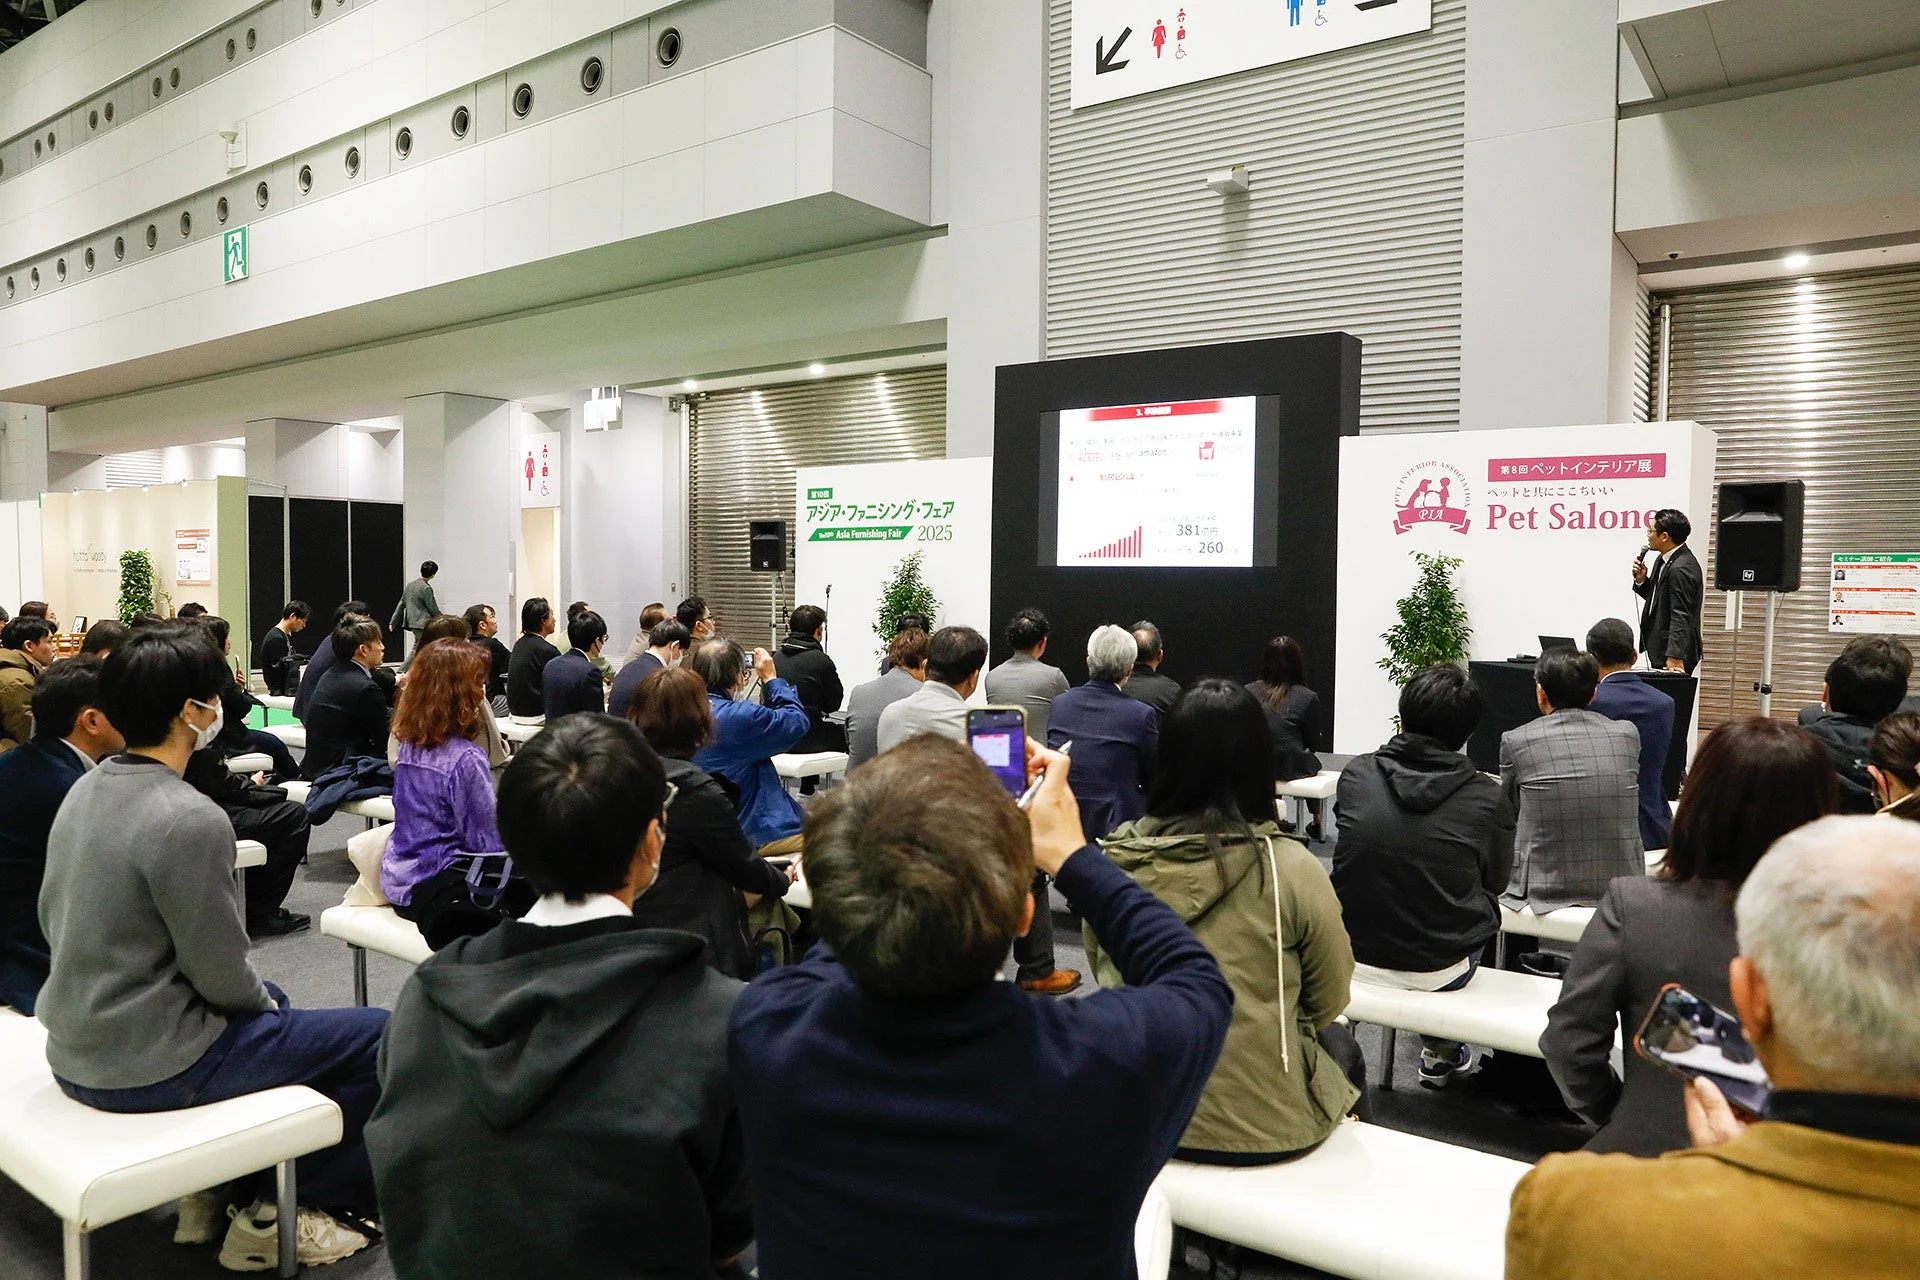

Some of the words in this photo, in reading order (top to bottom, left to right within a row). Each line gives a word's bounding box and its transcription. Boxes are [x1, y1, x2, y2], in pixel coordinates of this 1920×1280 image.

[1400, 460, 1437, 484] INTERIOR
[1440, 461, 1471, 508] ASSOCIATION
[1487, 486, 1614, 498] ペットと共にここちいい
[806, 499, 955, 522] アジア・ファニシング・フェア
[1418, 509, 1444, 521] PIA
[1486, 504, 1538, 530] Pet
[835, 530, 851, 539] Asia
[851, 529, 887, 540] Furnishing
[888, 528, 902, 538] Fair
[918, 525, 953, 541] 2025
[1199, 541, 1224, 554] 260
